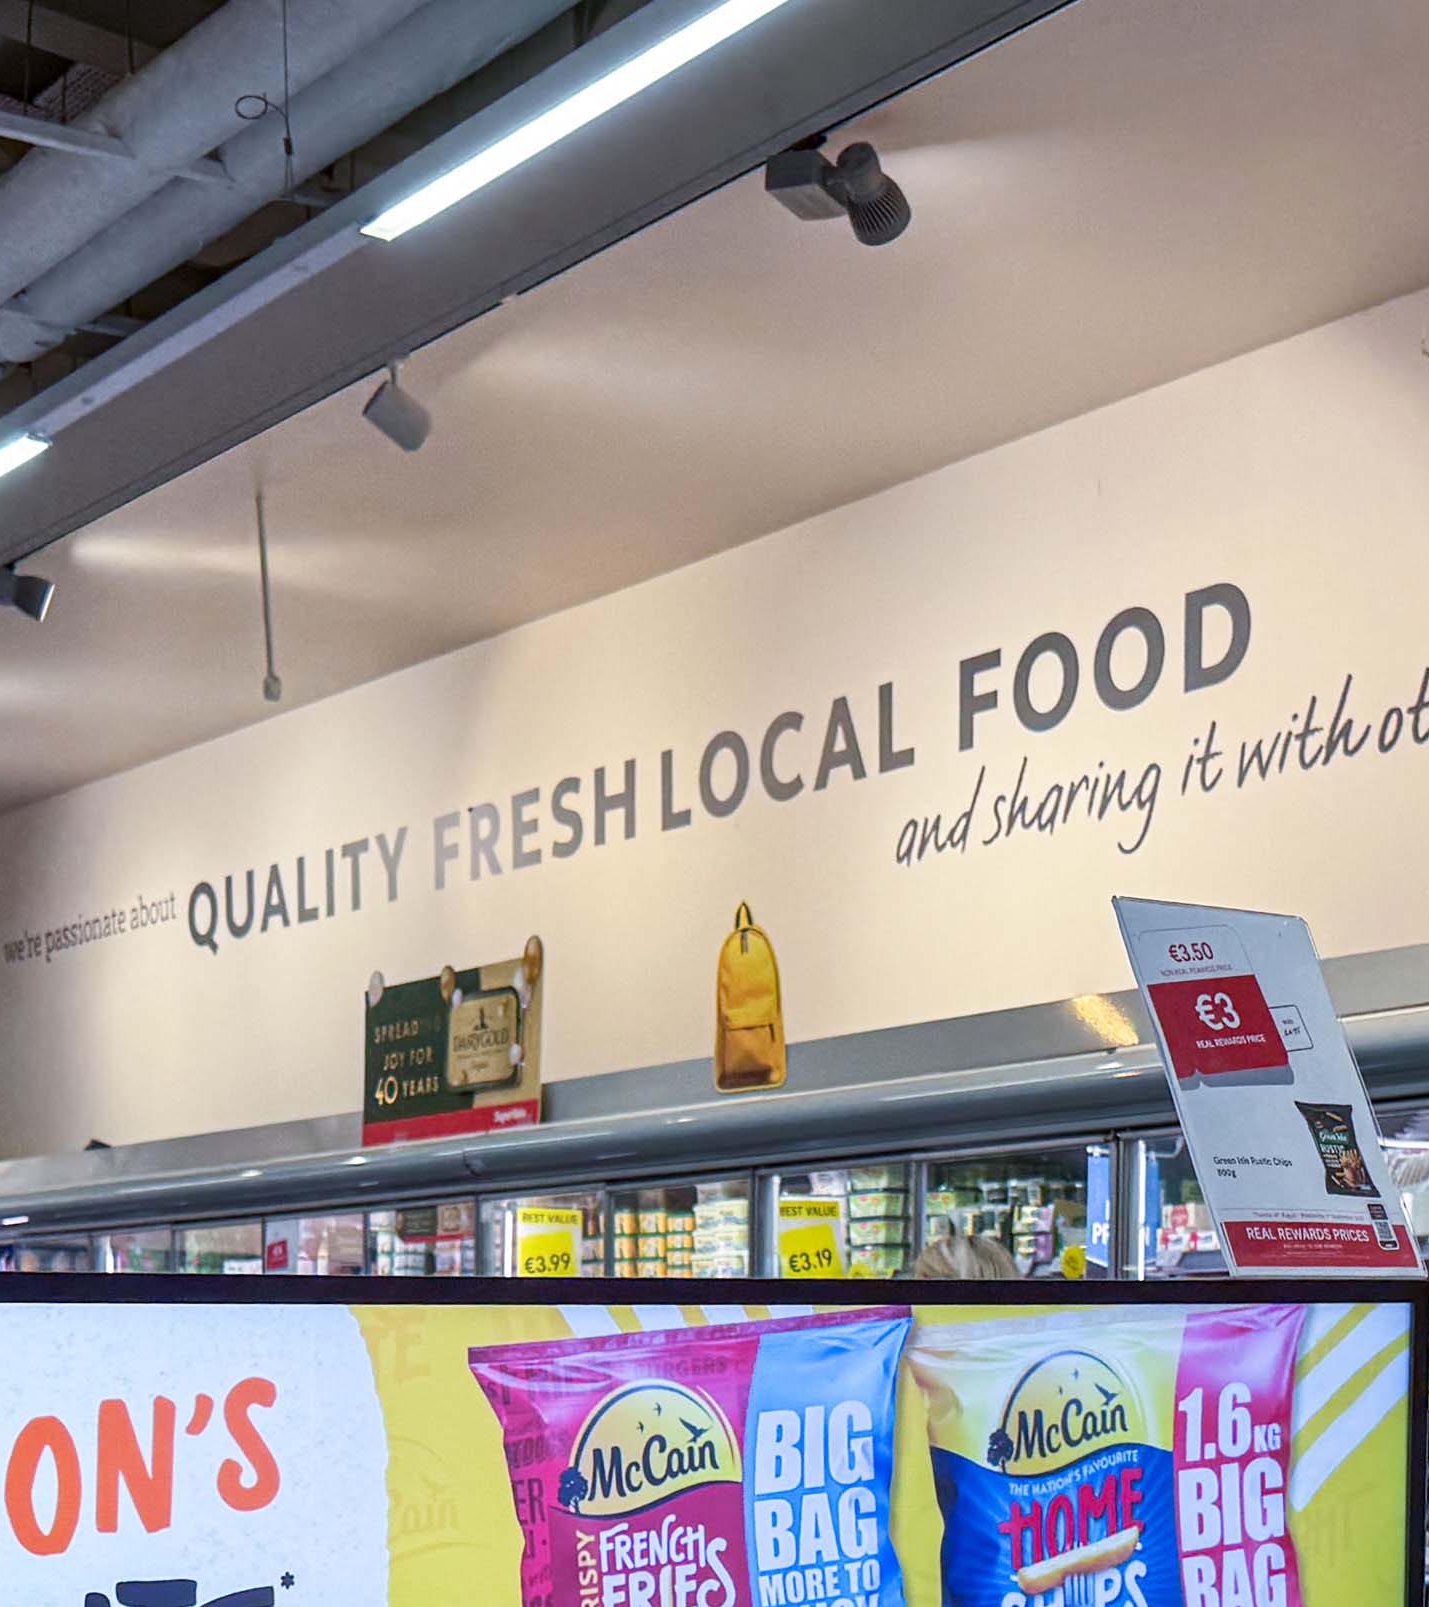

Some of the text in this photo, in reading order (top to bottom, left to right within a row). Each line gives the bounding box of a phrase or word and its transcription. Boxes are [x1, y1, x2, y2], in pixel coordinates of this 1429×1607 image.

[45, 907, 126, 963] passionate
[130, 890, 176, 930] about
[188, 826, 408, 955] QUALITY
[433, 758, 636, 890] FRESH
[660, 681, 916, 832] LOCAL
[958, 582, 1251, 753] FOOD
[896, 767, 986, 868] and
[982, 760, 1160, 854] sharing
[1180, 743, 1225, 798] it
[1234, 674, 1375, 786] with
[1169, 942, 1213, 962] €3.50
[1195, 992, 1240, 1031] €3
[1196, 1034, 1266, 1049] REAL REWARDS PRICE
[375, 1076, 439, 1105] 40 YEARS
[780, 1202, 838, 1218] BEST VALUE
[1246, 1227, 1370, 1242] REAL REWARDS PRICES
[524, 1254, 570, 1274] €3.99
[789, 1250, 832, 1272] €3.19
[754, 1401, 874, 1496] BIG
[1014, 1398, 1128, 1461] McCain
[588, 1434, 718, 1501] McCain
[1008, 1482, 1028, 1496] THE
[1082, 1450, 1139, 1478] FAVOURITE
[999, 1468, 1144, 1570] HOME
[1178, 1457, 1285, 1552] BIG
[600, 1515, 706, 1572] FRENCH
[754, 1487, 878, 1571] BAG
[844, 1558, 881, 1592] TO
